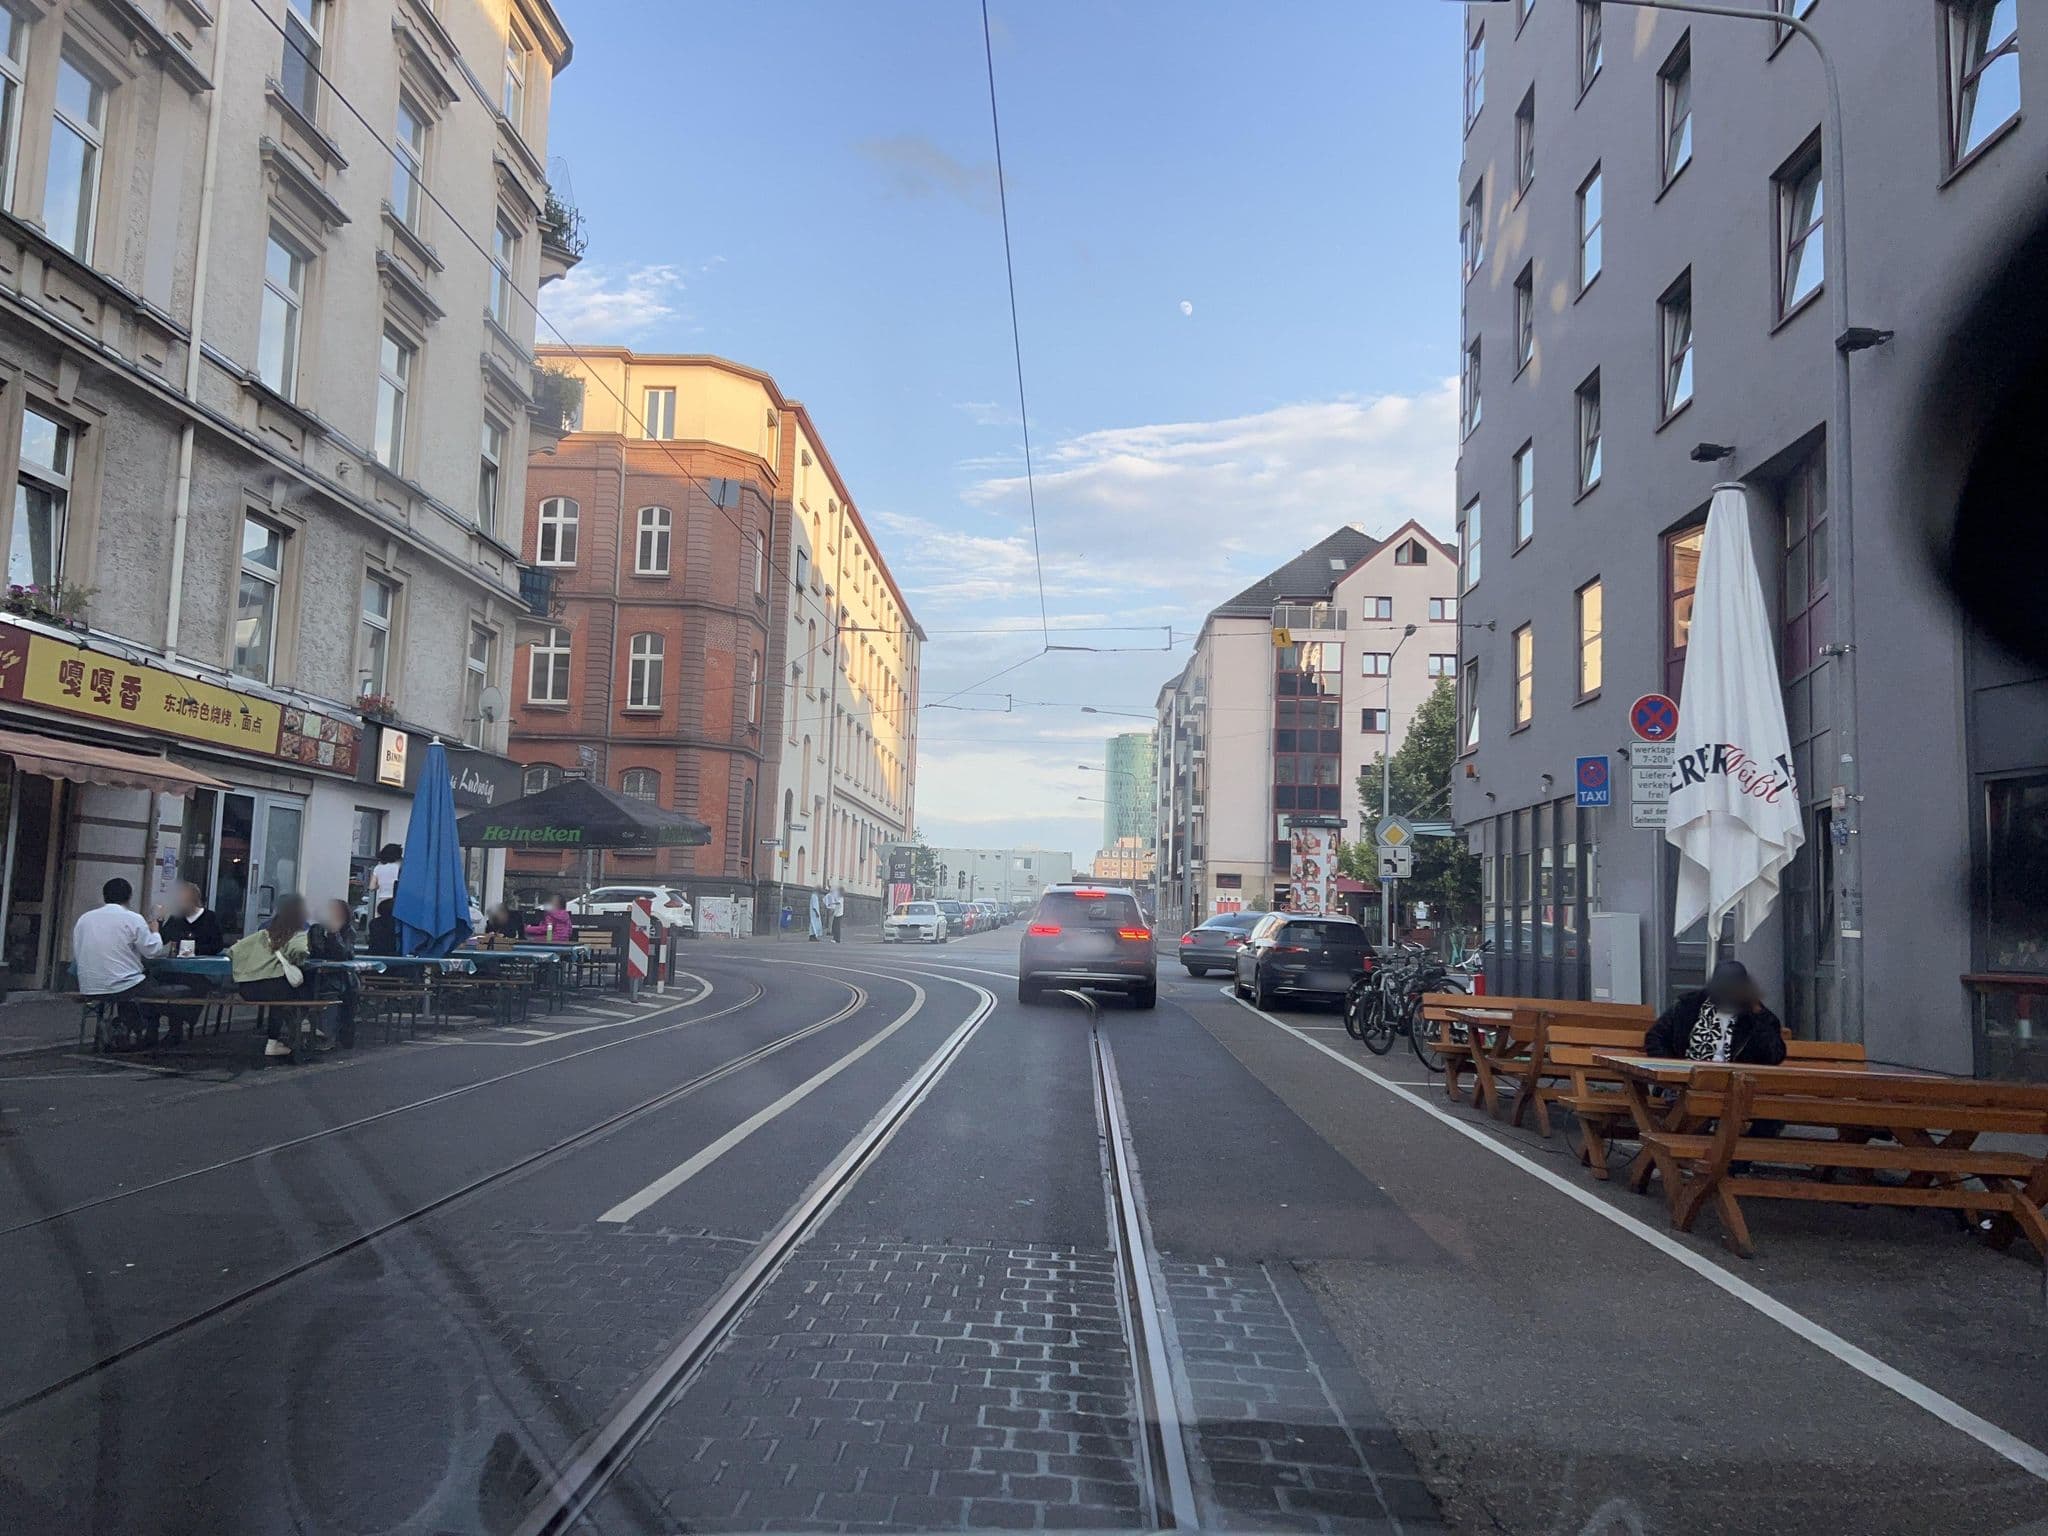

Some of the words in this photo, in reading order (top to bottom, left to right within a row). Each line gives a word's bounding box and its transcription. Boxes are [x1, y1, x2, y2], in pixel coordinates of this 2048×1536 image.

[58, 659, 142, 711] 嘎嘎香
[458, 767, 495, 805] Ludwig
[1637, 781, 1669, 789] verkeh
[1580, 791, 1607, 803] TAXI
[1648, 790, 1664, 799] frei
[482, 825, 582, 842] Heineken
